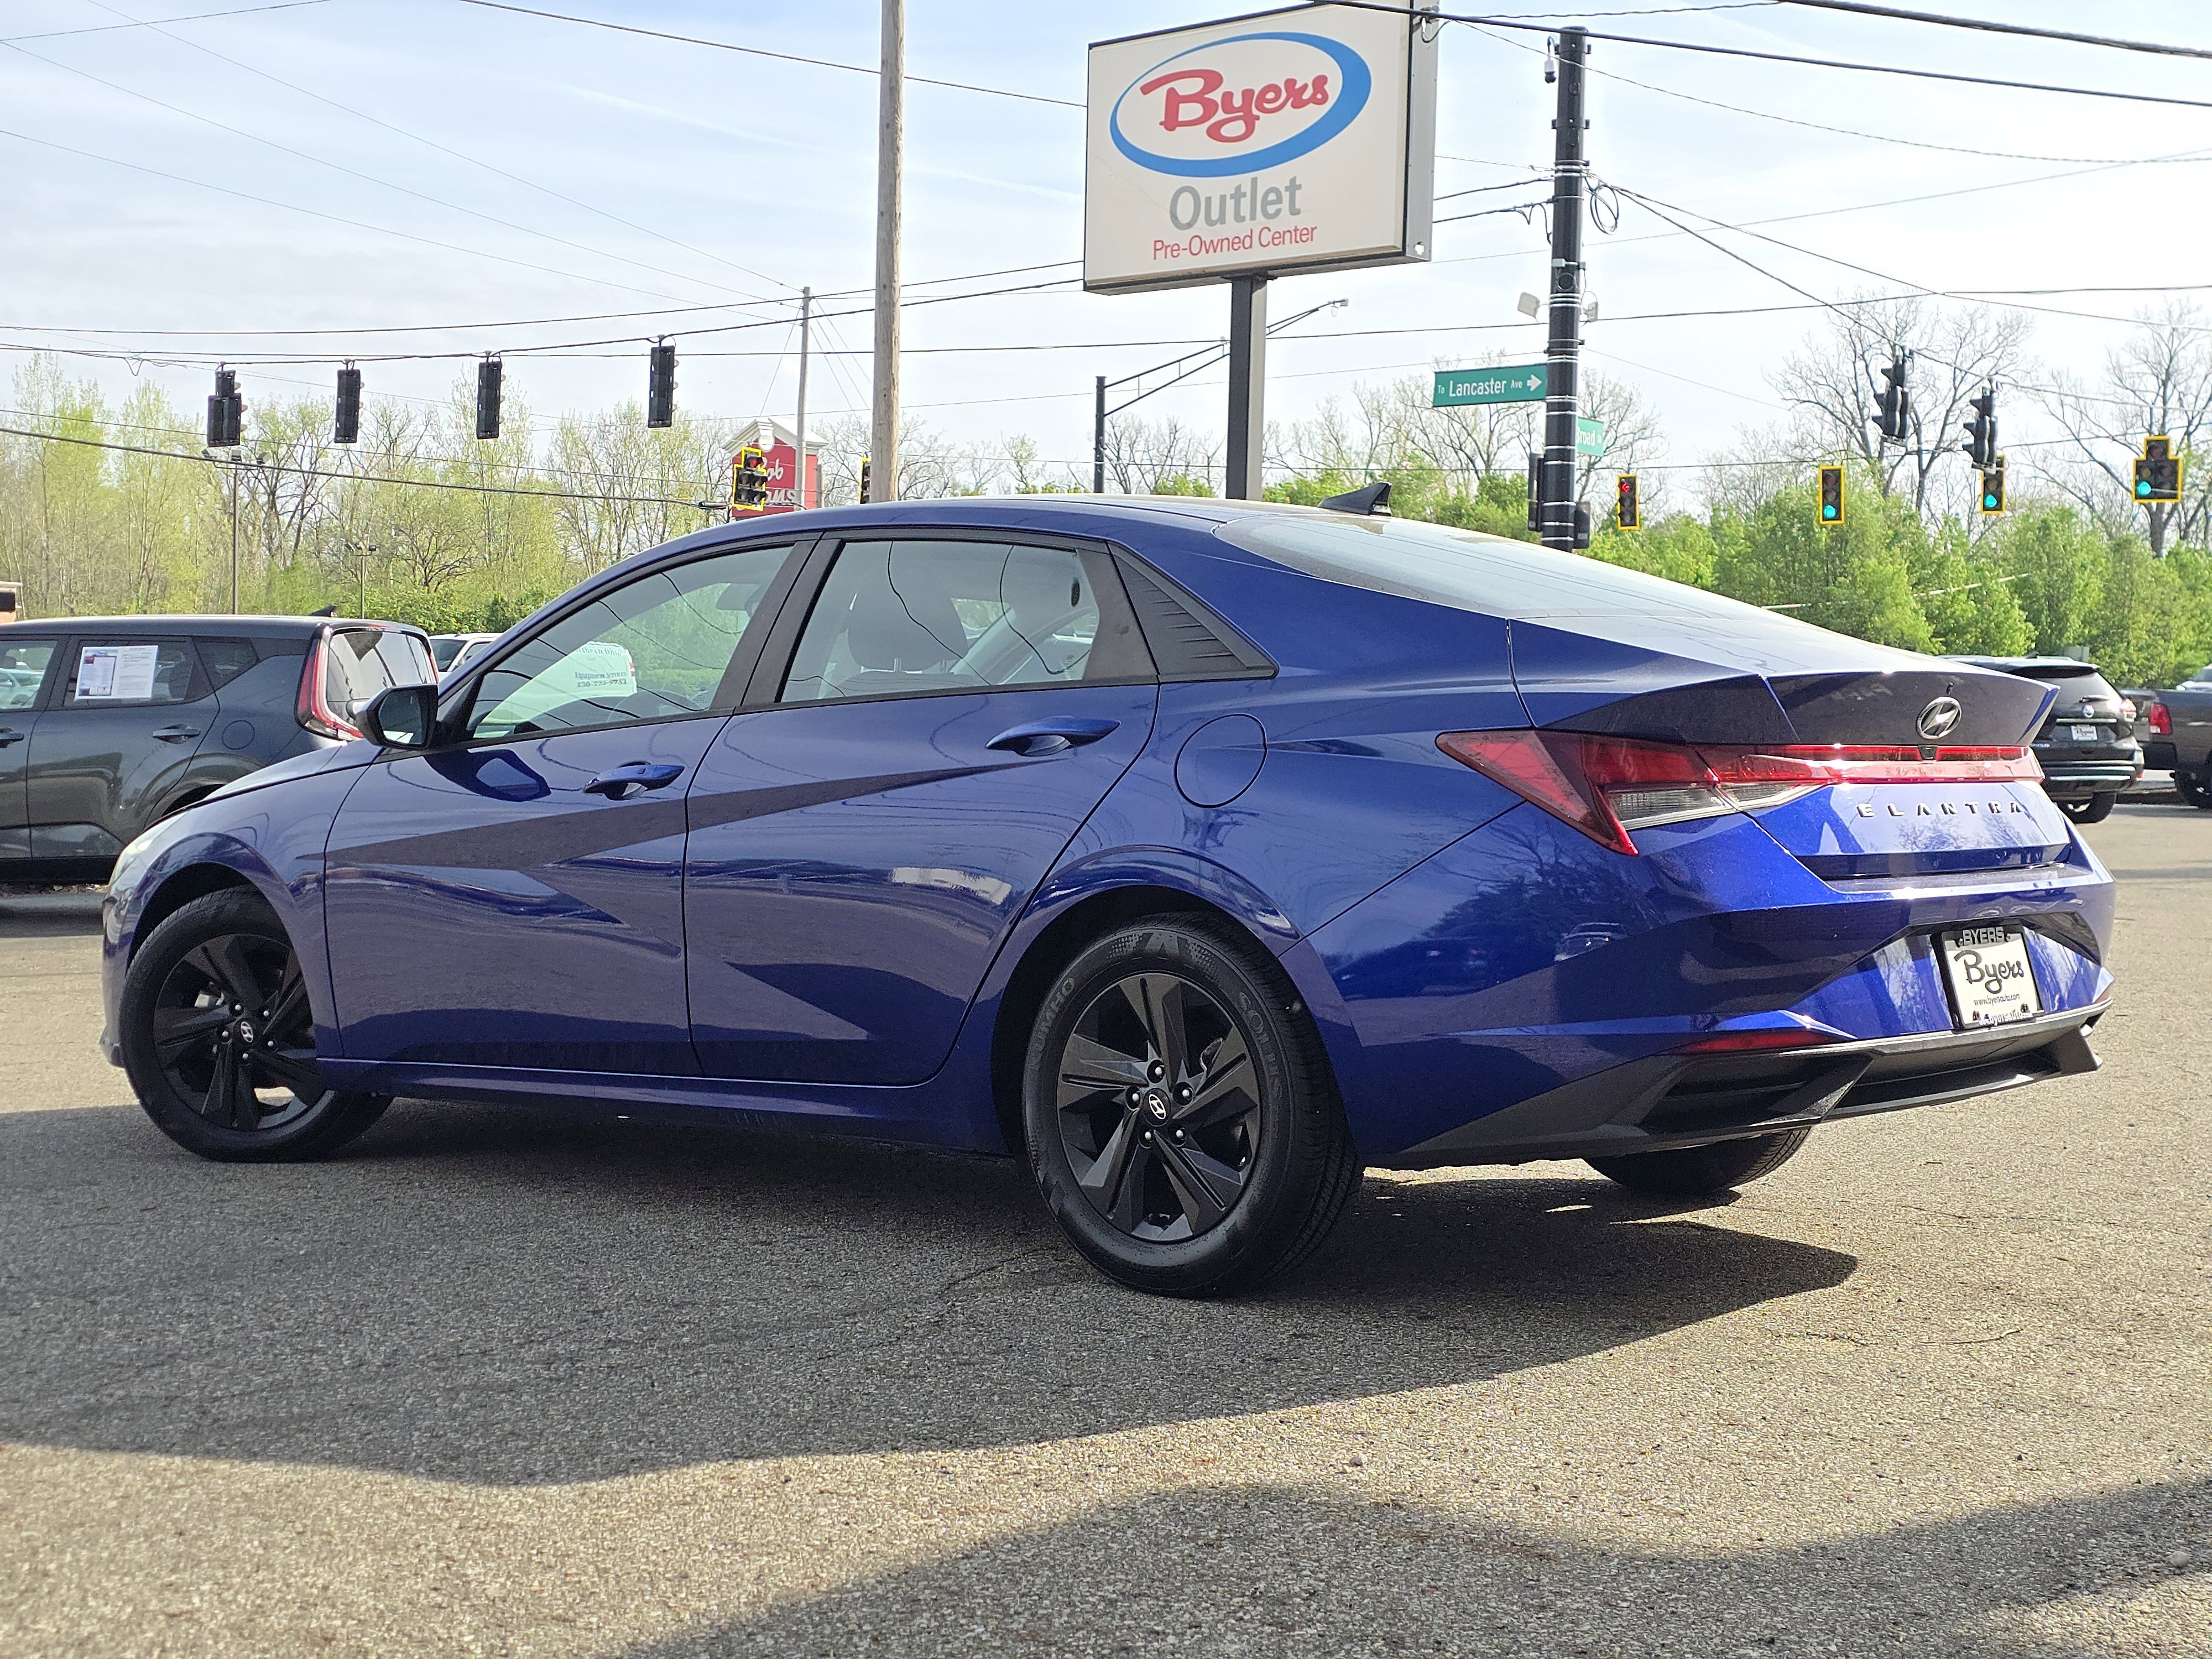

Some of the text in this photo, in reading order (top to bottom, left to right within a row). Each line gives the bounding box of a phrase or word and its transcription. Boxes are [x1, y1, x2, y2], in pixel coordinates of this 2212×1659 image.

[1140, 69, 1328, 143] Byers
[1170, 175, 1302, 231] Outlet
[1153, 223, 1318, 260] Pre-Owned Center
[1437, 377, 1523, 397] To Lancaster Ave
[761, 457, 784, 481] ob
[1856, 801, 2023, 818] ELANTRA
[1962, 926, 2005, 946] BYERS
[1953, 950, 2025, 994] Byers
[1973, 993, 2021, 1007] www.byersauto.com
